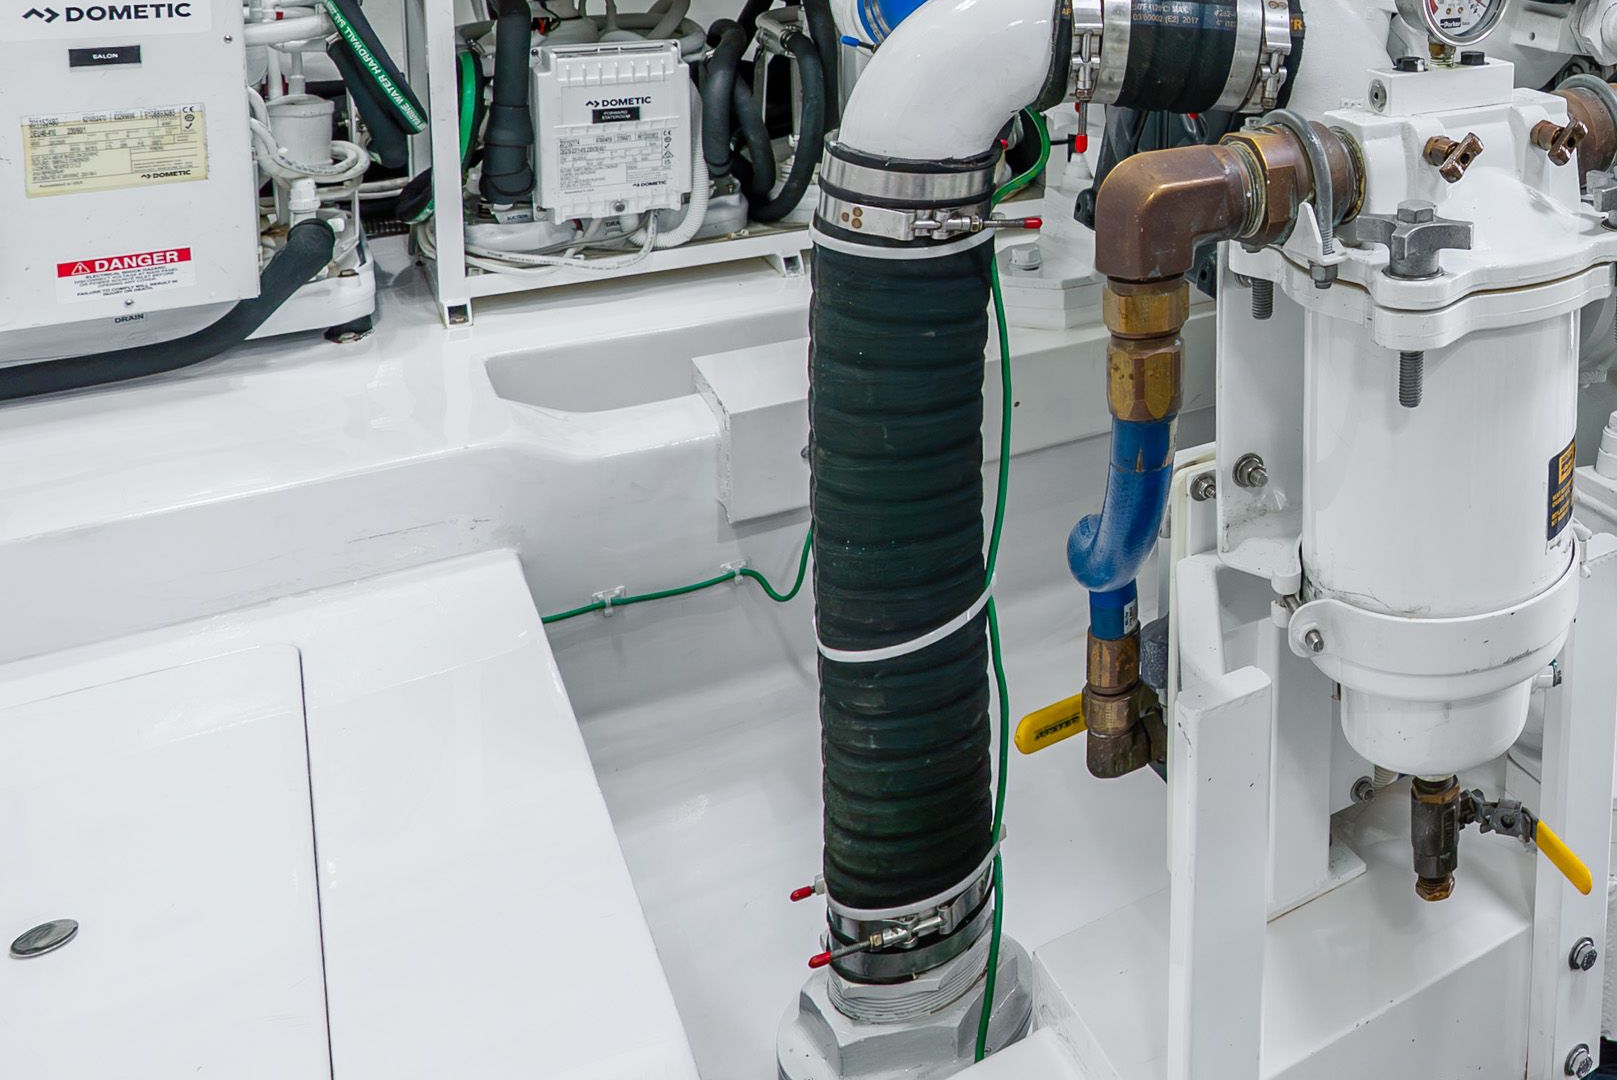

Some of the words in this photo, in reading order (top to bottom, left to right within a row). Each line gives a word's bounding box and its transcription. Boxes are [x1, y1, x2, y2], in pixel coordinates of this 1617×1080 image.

[65, 3, 192, 22] DOMETIC
[1182, 16, 1199, 25] 2017
[1291, 19, 1303, 30] R
[344, 26, 381, 75] HARDWALL
[378, 74, 406, 105] WATER
[602, 96, 651, 107] DOMETIC
[153, 170, 191, 179] DOMETIC
[94, 251, 179, 272] DANGER
[114, 313, 144, 324] DRAIN
